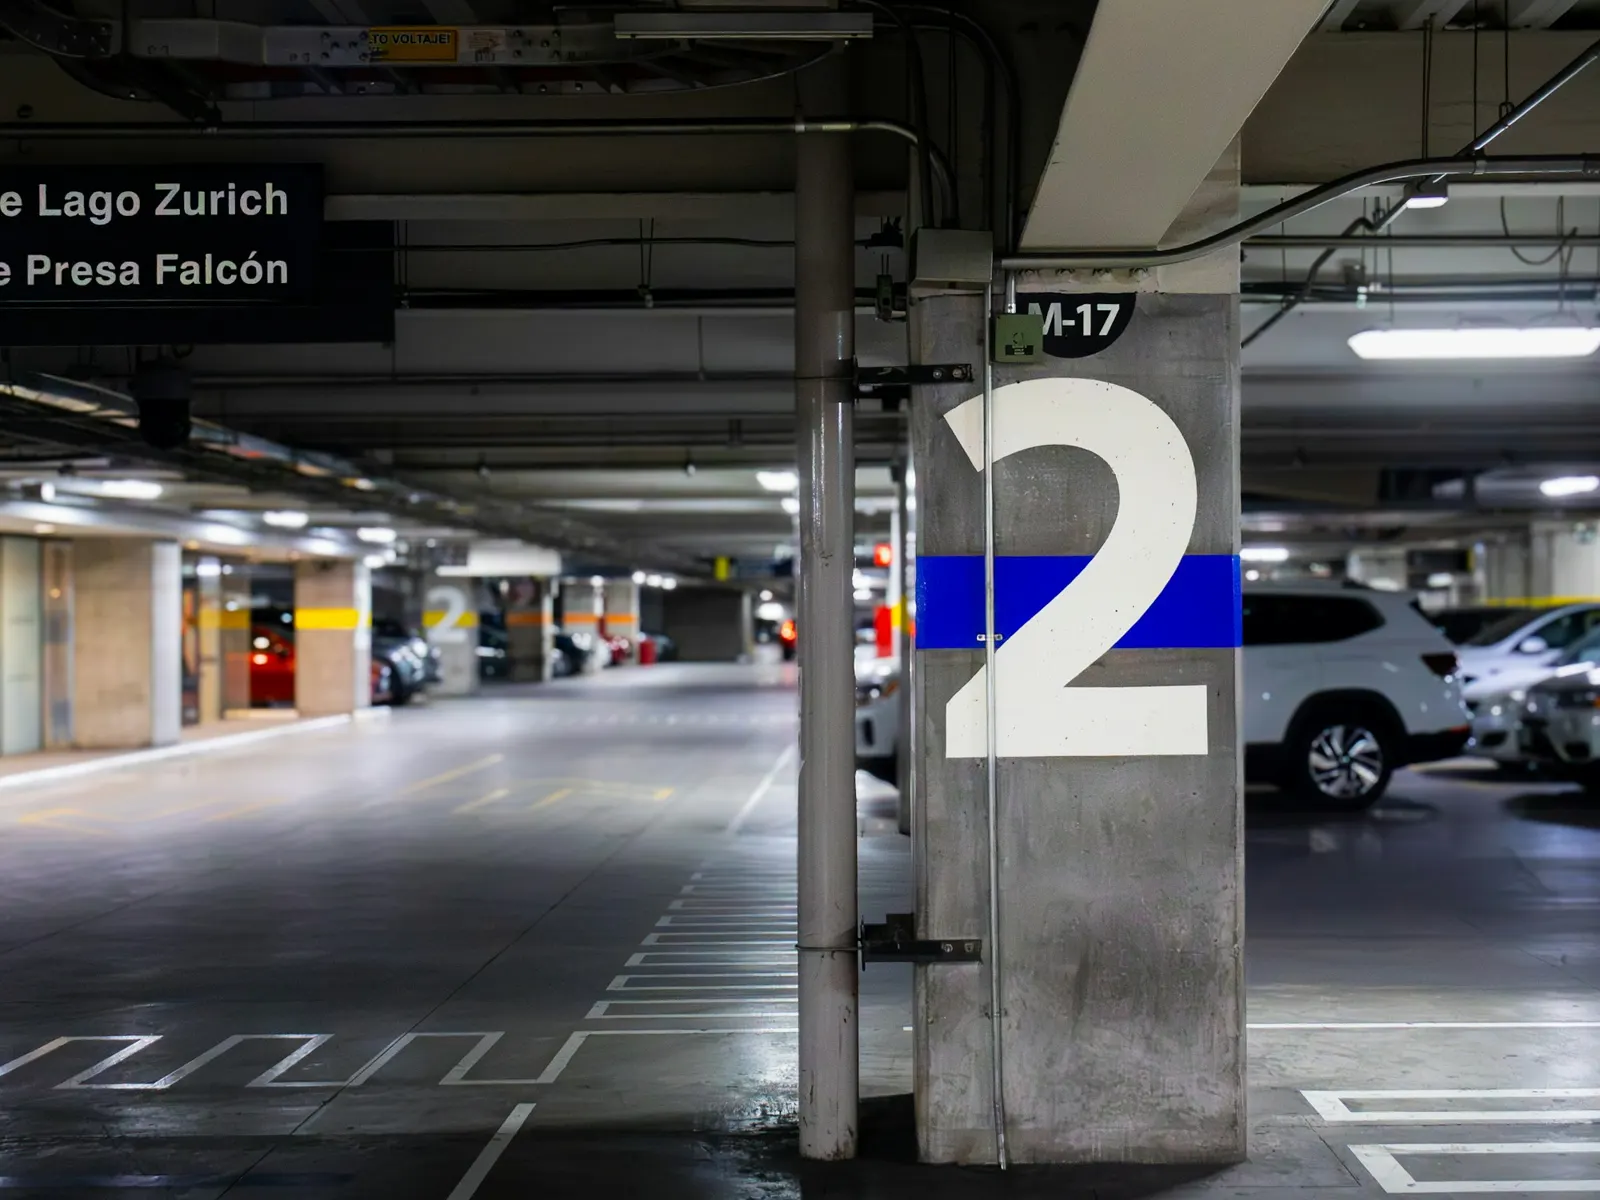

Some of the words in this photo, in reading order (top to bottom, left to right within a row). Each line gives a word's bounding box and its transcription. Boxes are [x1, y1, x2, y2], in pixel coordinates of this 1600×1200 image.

[391, 34, 451, 44] VOLTAJE!
[38, 183, 141, 226] Lago
[154, 182, 288, 216] Zurich
[27, 254, 141, 286] Presa
[156, 251, 288, 286] Falcón
[1028, 303, 1120, 336] M-17
[944, 377, 1208, 758] 2
[427, 586, 467, 642] 2
